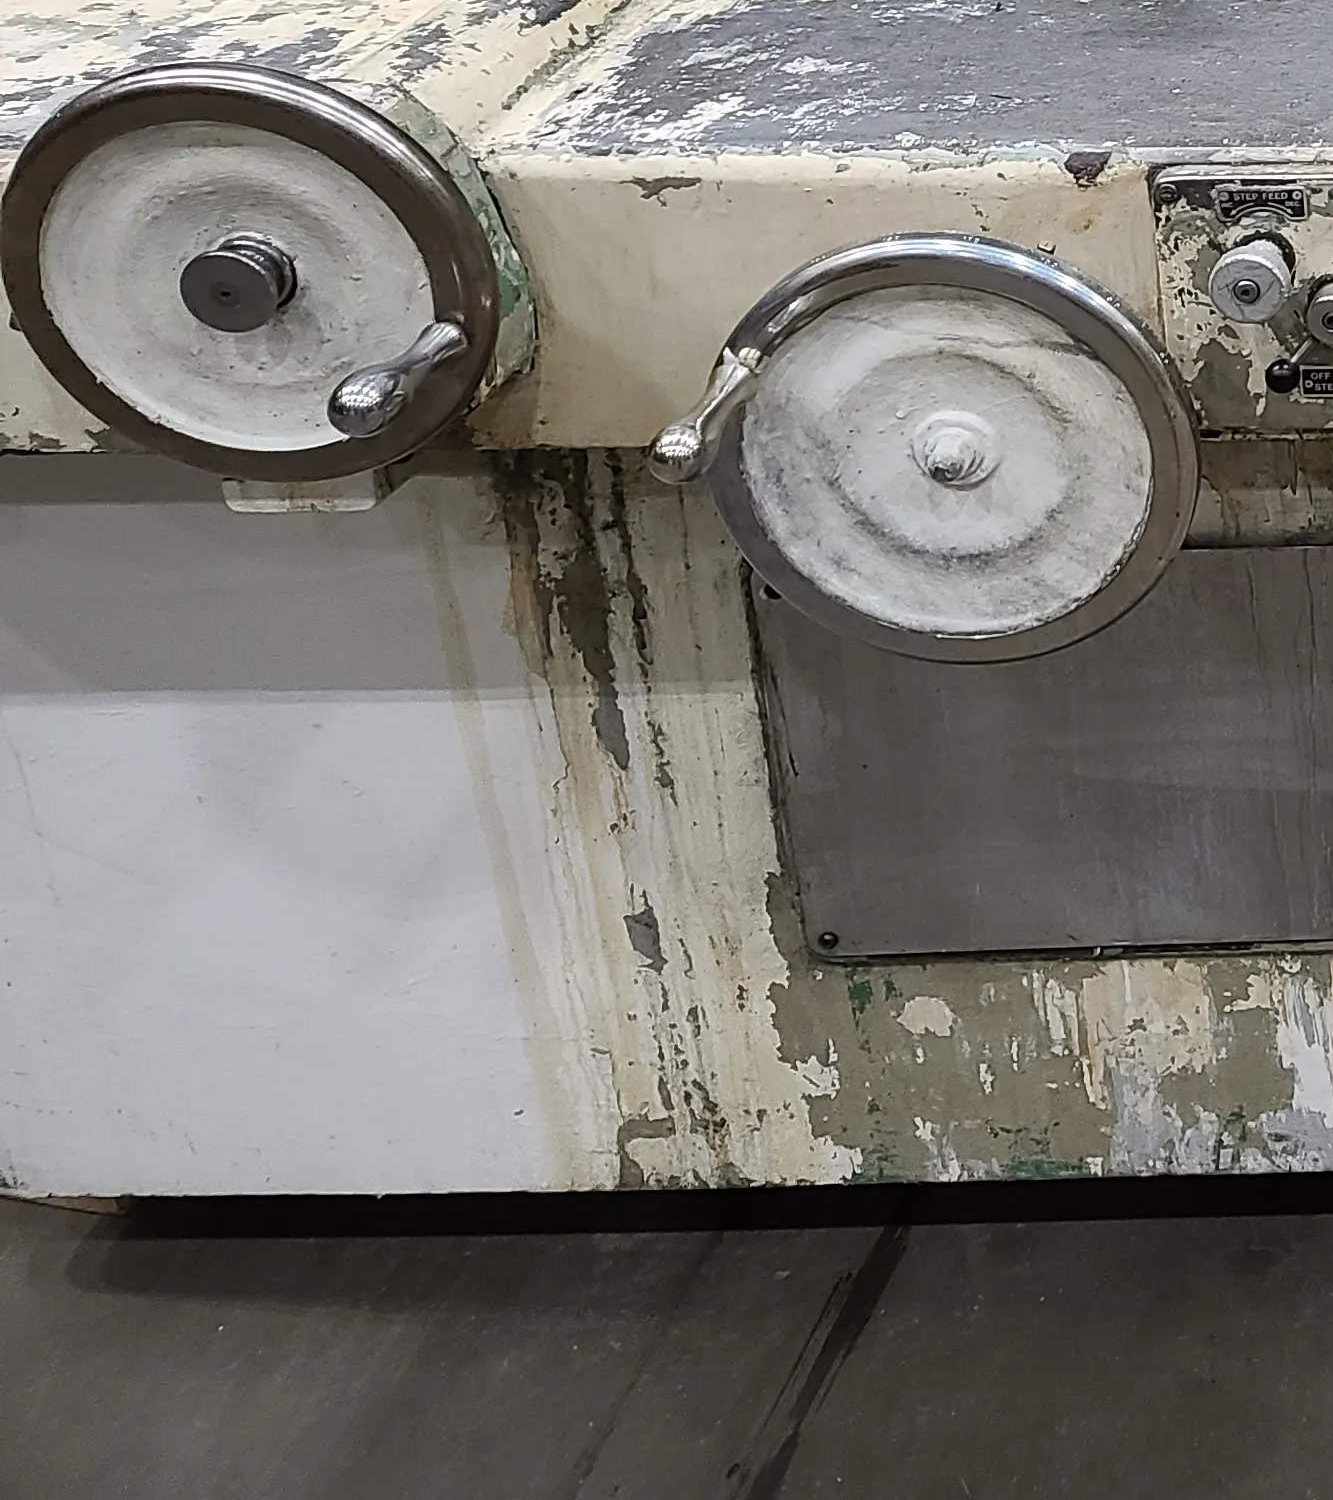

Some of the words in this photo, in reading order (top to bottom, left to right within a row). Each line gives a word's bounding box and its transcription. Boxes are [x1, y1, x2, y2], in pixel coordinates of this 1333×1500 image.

[1233, 192, 1258, 200] STEP
[1262, 192, 1288, 200] FEED
[1310, 372, 1330, 380] OFF
